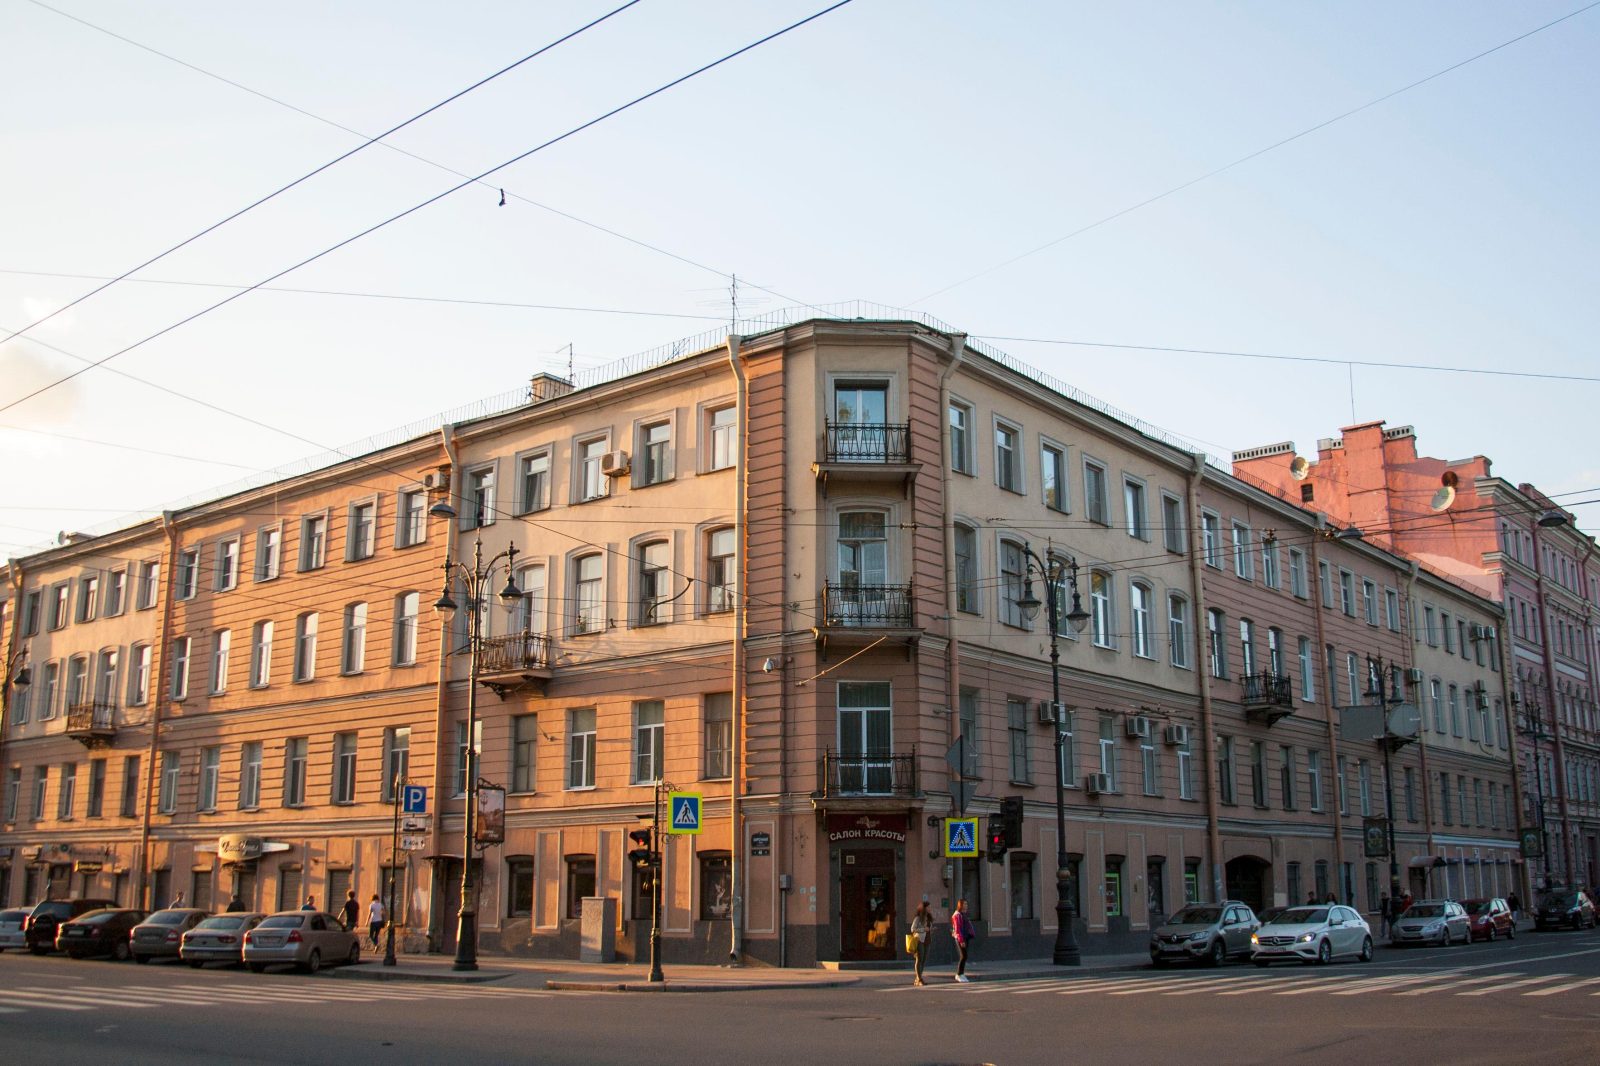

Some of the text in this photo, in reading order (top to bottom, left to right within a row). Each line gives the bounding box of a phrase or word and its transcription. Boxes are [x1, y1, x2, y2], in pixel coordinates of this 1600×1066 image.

[409, 788, 423, 811] P
[830, 829, 905, 842] САЛОН КРАСОТЫ
